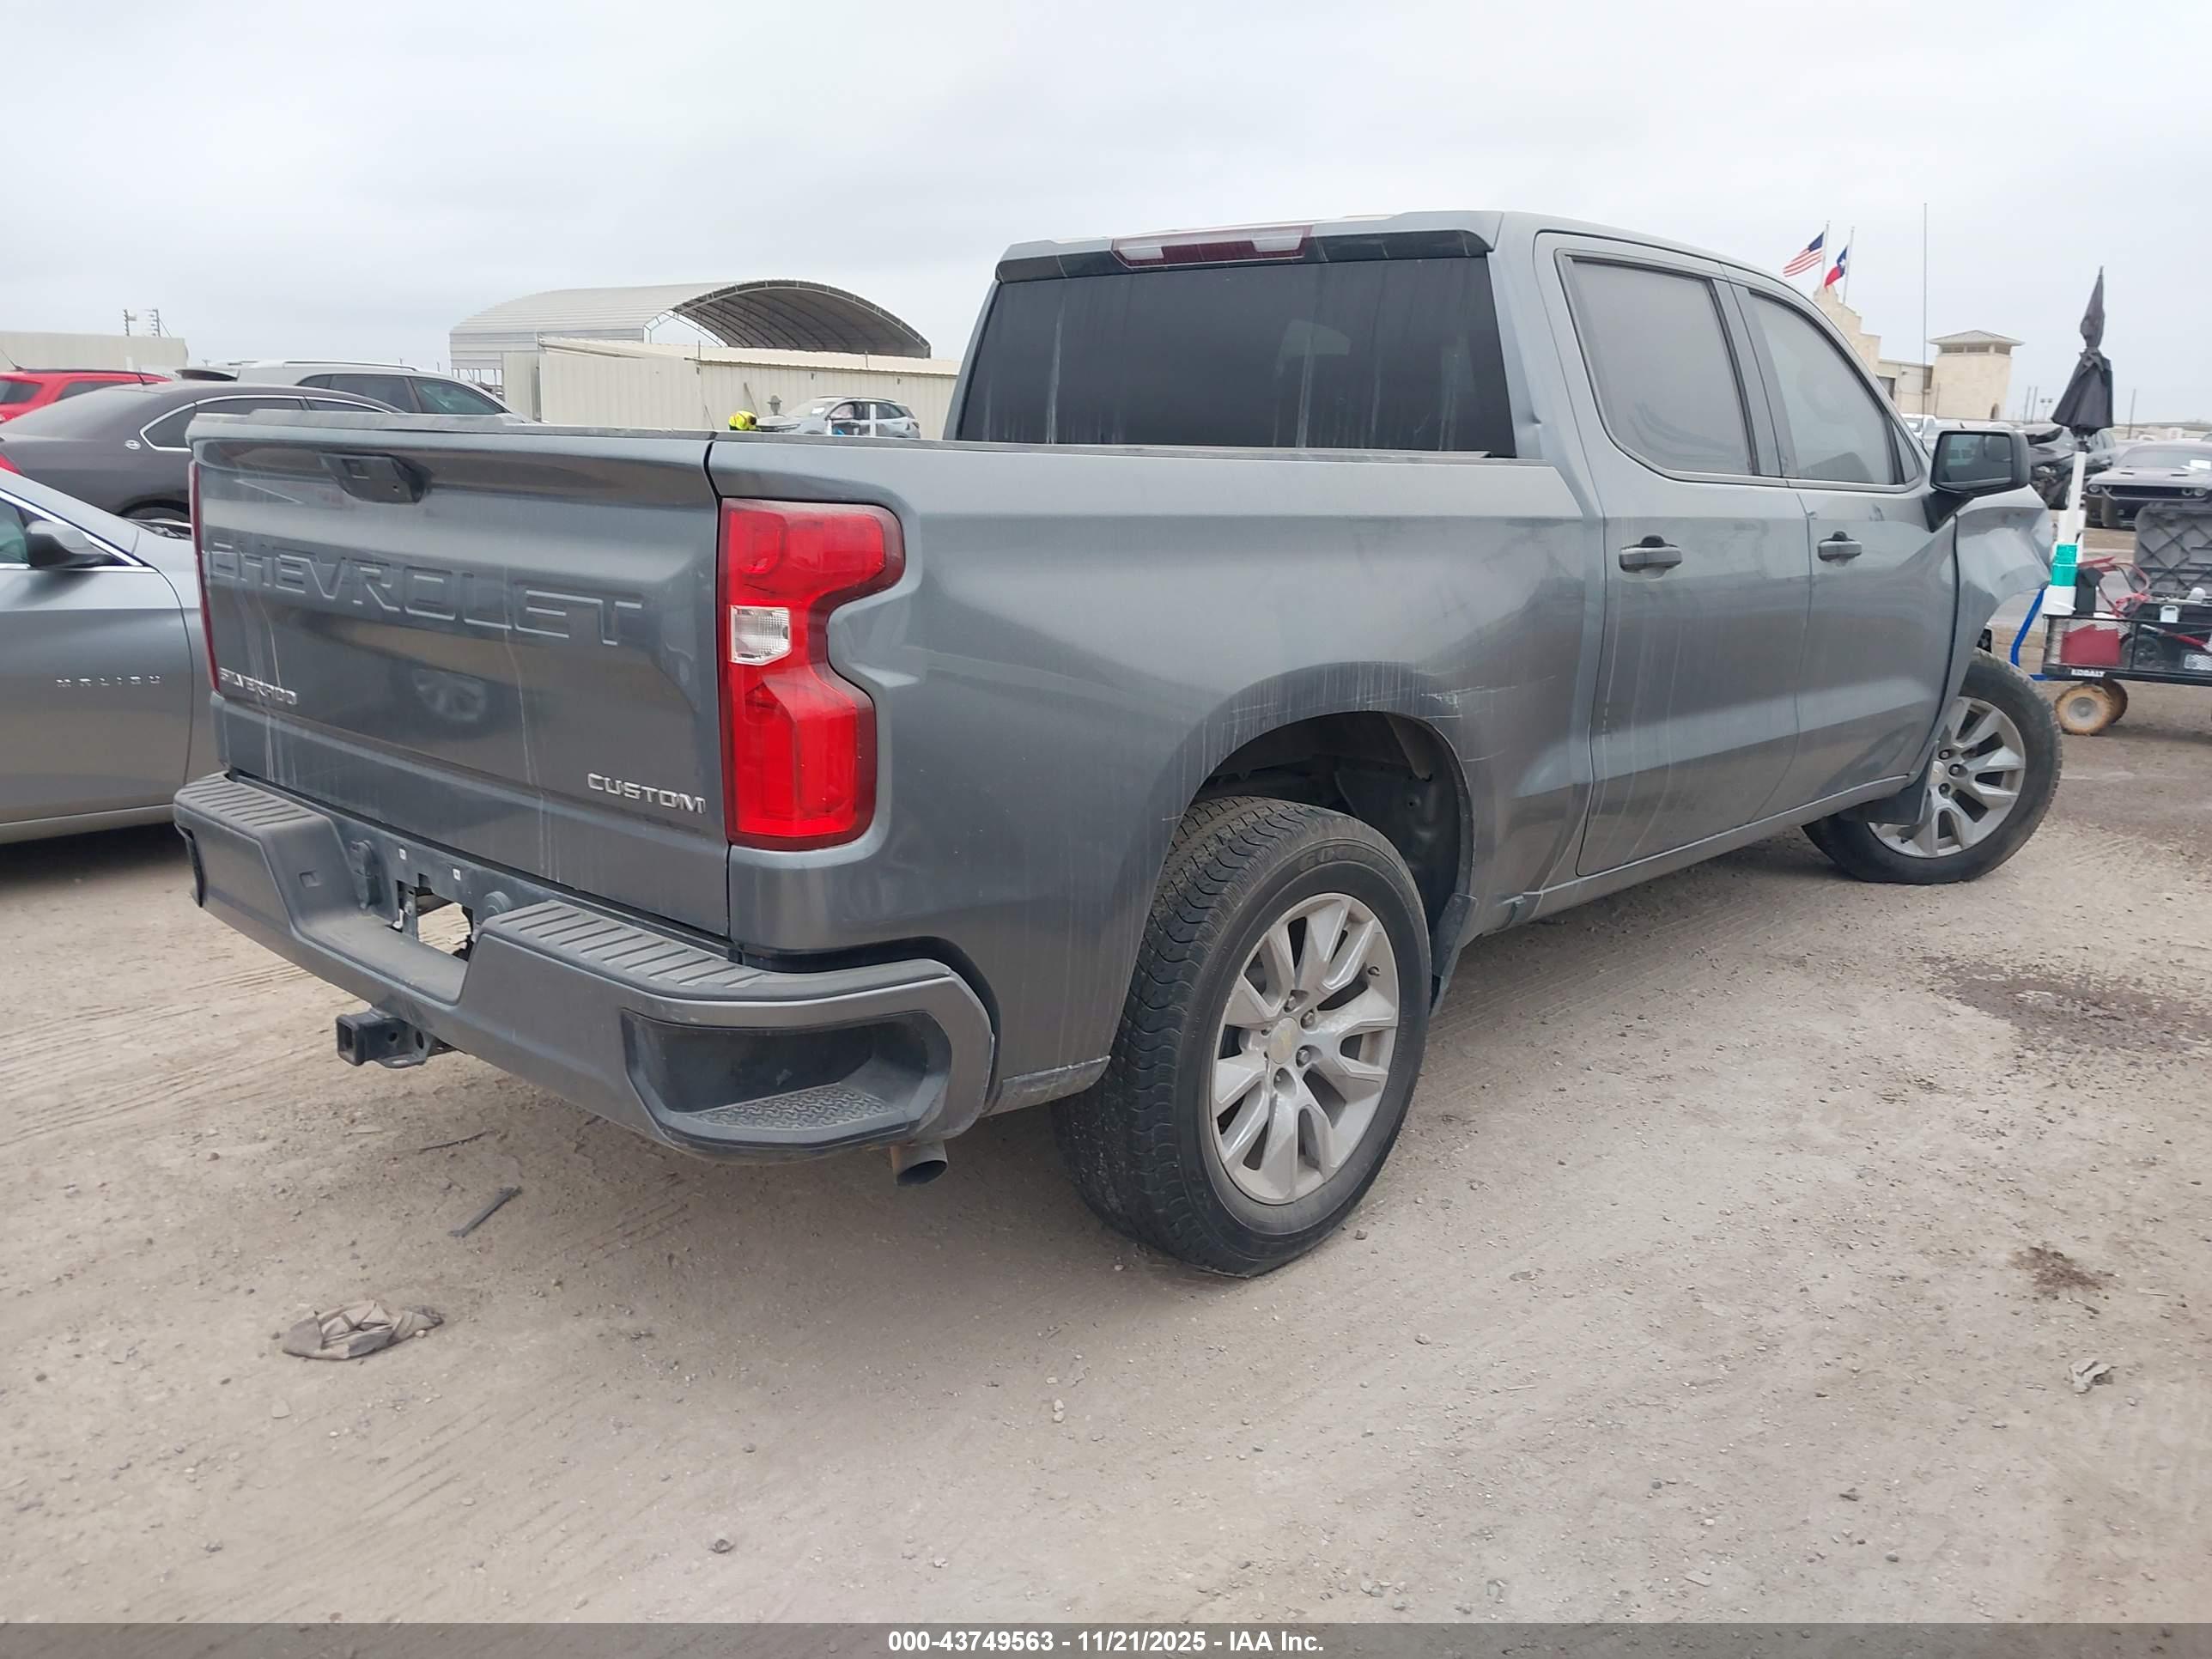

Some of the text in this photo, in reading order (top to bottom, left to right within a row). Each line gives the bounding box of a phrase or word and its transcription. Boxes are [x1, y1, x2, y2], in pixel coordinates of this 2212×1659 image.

[204, 538, 644, 647] CHEVROLET
[55, 674, 162, 688] MALIBU
[587, 772, 707, 814] CUSTOM
